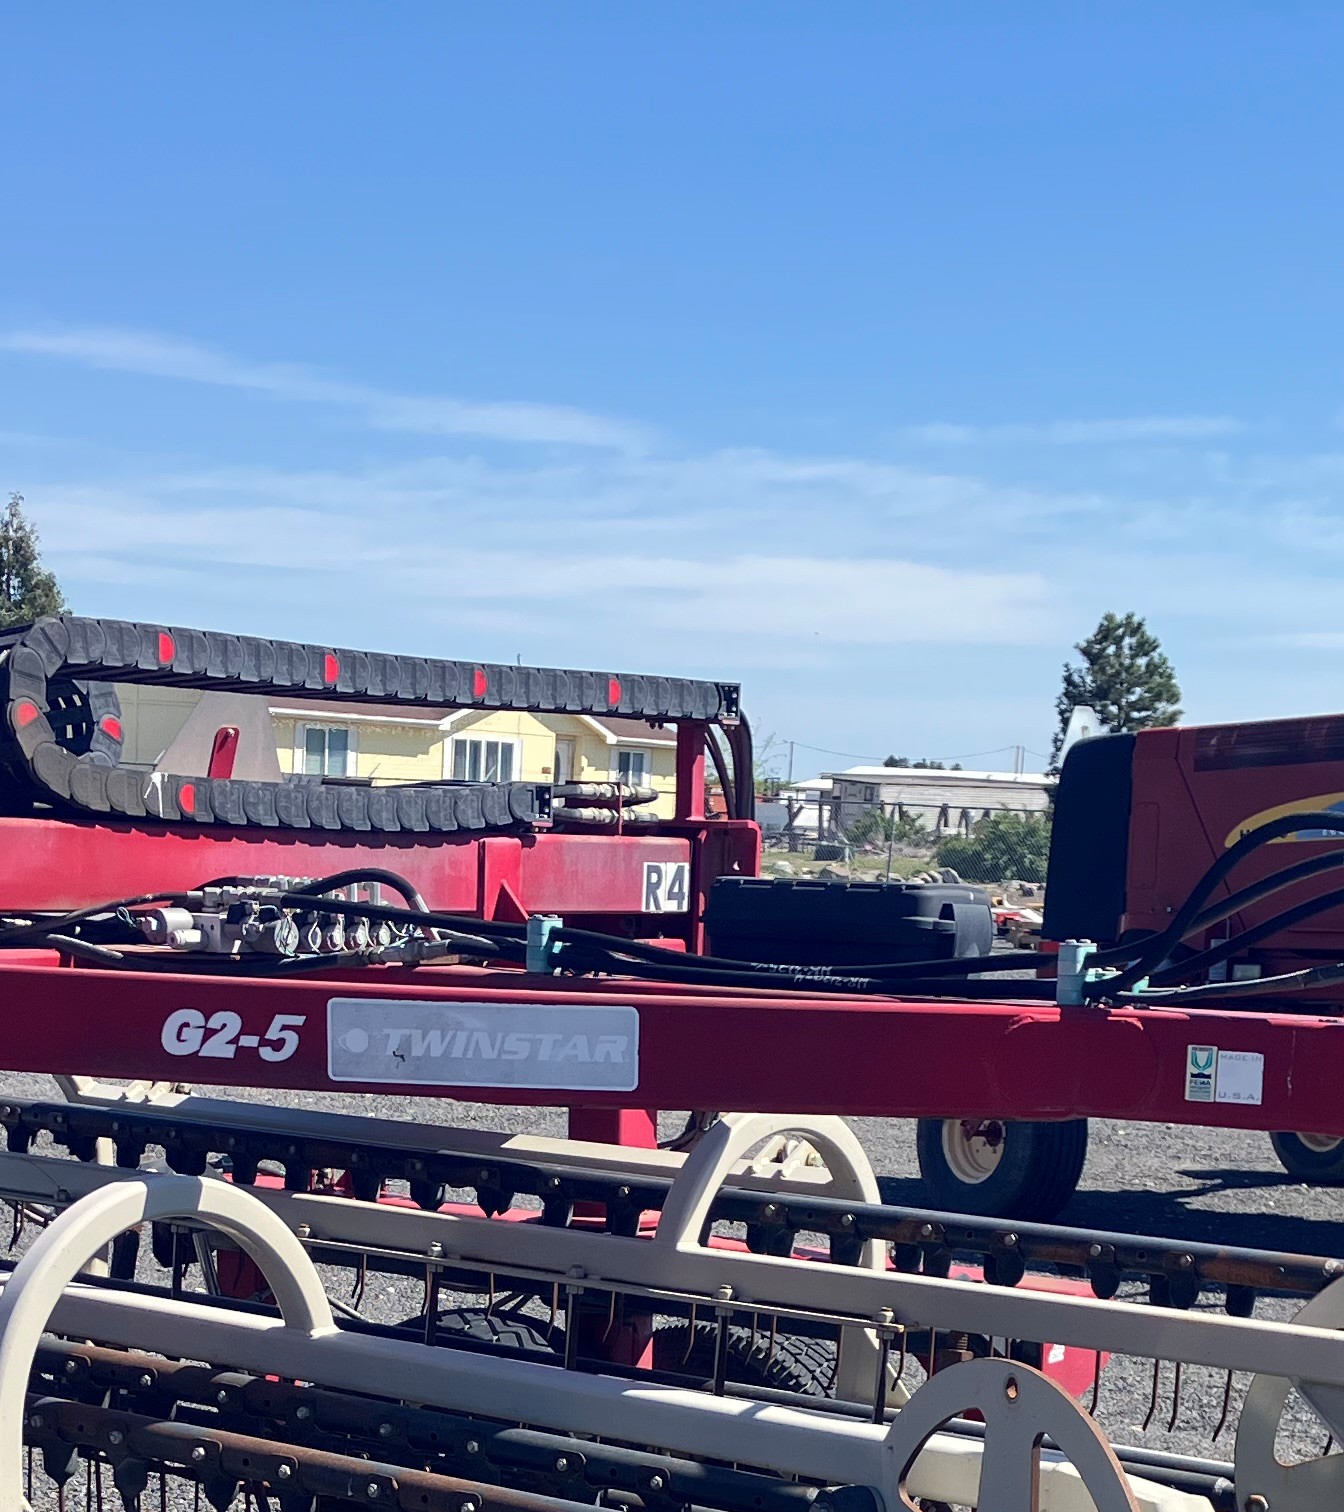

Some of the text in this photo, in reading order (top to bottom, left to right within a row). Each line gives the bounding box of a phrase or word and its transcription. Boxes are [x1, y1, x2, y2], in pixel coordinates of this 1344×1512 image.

[645, 864, 686, 911] R4
[160, 1008, 307, 1062] G2-5
[383, 1027, 630, 1064] TWINSTAR
[1220, 1053, 1248, 1061] MADE
[1218, 1090, 1260, 1102] U.S.A.
